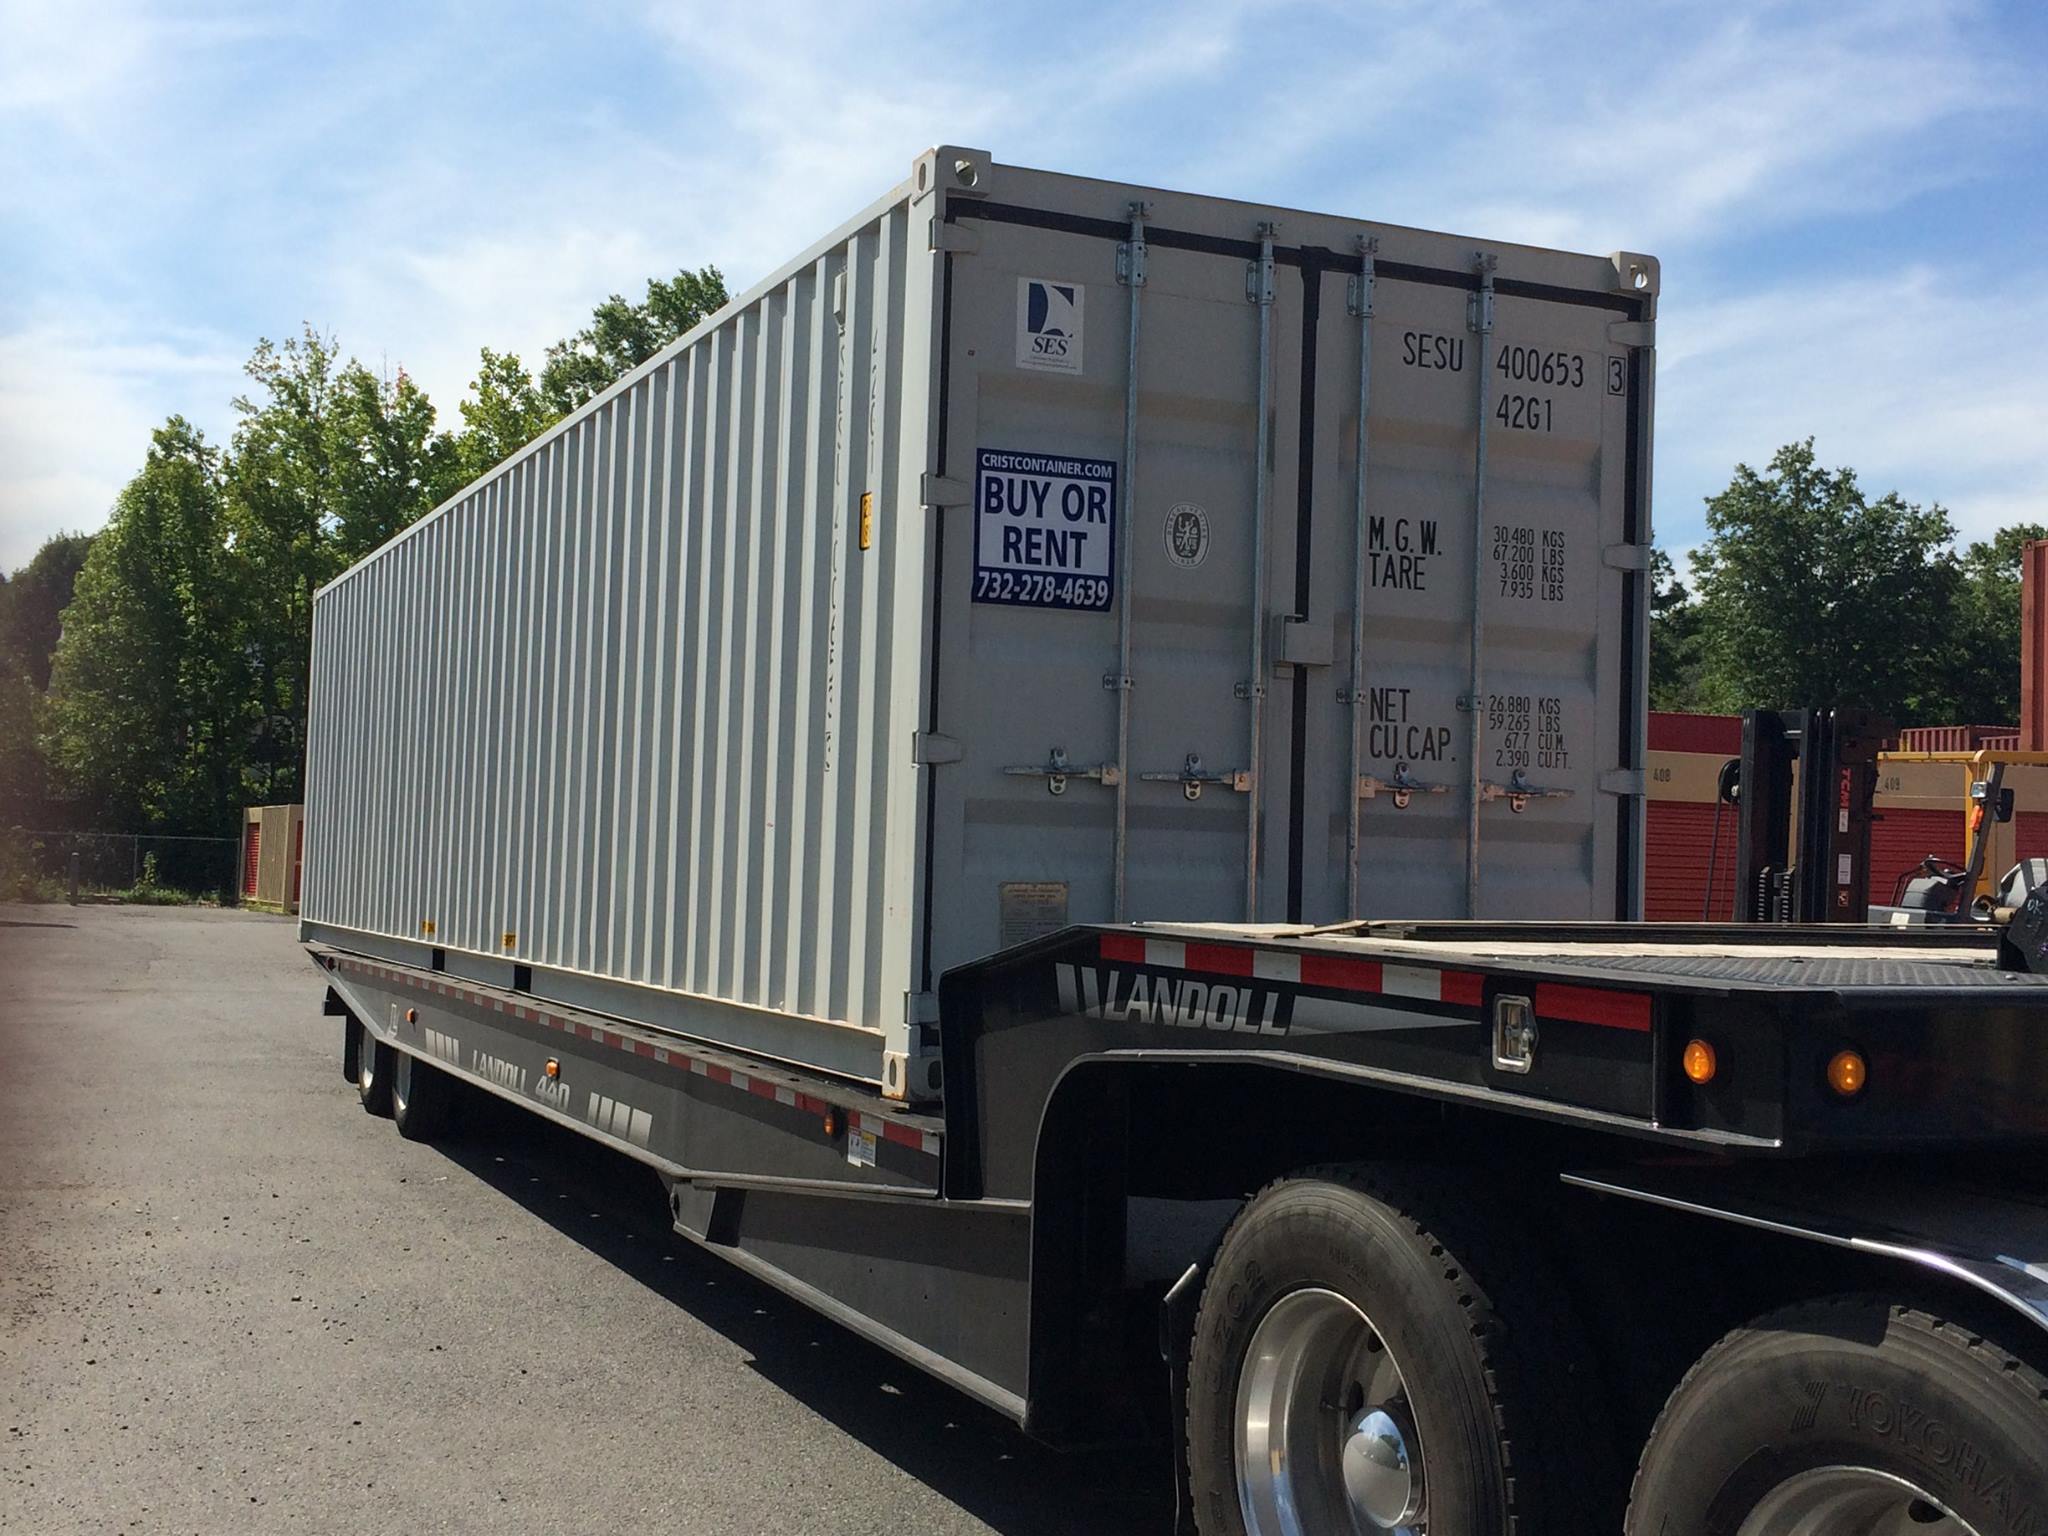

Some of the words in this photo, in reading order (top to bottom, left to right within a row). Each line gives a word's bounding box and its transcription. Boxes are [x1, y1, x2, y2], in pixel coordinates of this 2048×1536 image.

[1032, 336, 1068, 356] SES
[1402, 332, 1464, 372] SESU
[1496, 345, 1584, 388] 400653
[1610, 360, 1624, 393] 3
[1496, 394, 1552, 432] 42G1
[981, 453, 1113, 480] CRISTCONTAINER.COM
[984, 475, 1052, 519] BUY
[1060, 483, 1107, 524] OR
[1002, 525, 1088, 569] RENT
[1493, 525, 1535, 546] 30.480
[1542, 529, 1565, 549] KGS
[1493, 543, 1534, 563] 67.200
[1541, 547, 1565, 567] LBS
[976, 570, 1110, 607] 732-278-4639
[1369, 552, 1427, 591] TARE
[1500, 563, 1534, 582] 3.600
[1541, 565, 1564, 584] KGS
[1500, 580, 1534, 599] 7.935
[1541, 583, 1564, 601] LBS
[1369, 687, 1411, 723] NET
[1538, 697, 1561, 716] KGS
[1488, 714, 1530, 732] 59.265
[1538, 715, 1560, 734] LBS
[1369, 724, 1456, 762] CU.CAP.
[1504, 731, 1529, 750] 67.7
[1495, 750, 1529, 768] 2.390
[1103, 970, 1288, 1036] LANDOLL
[472, 1049, 528, 1095] LANDOLL
